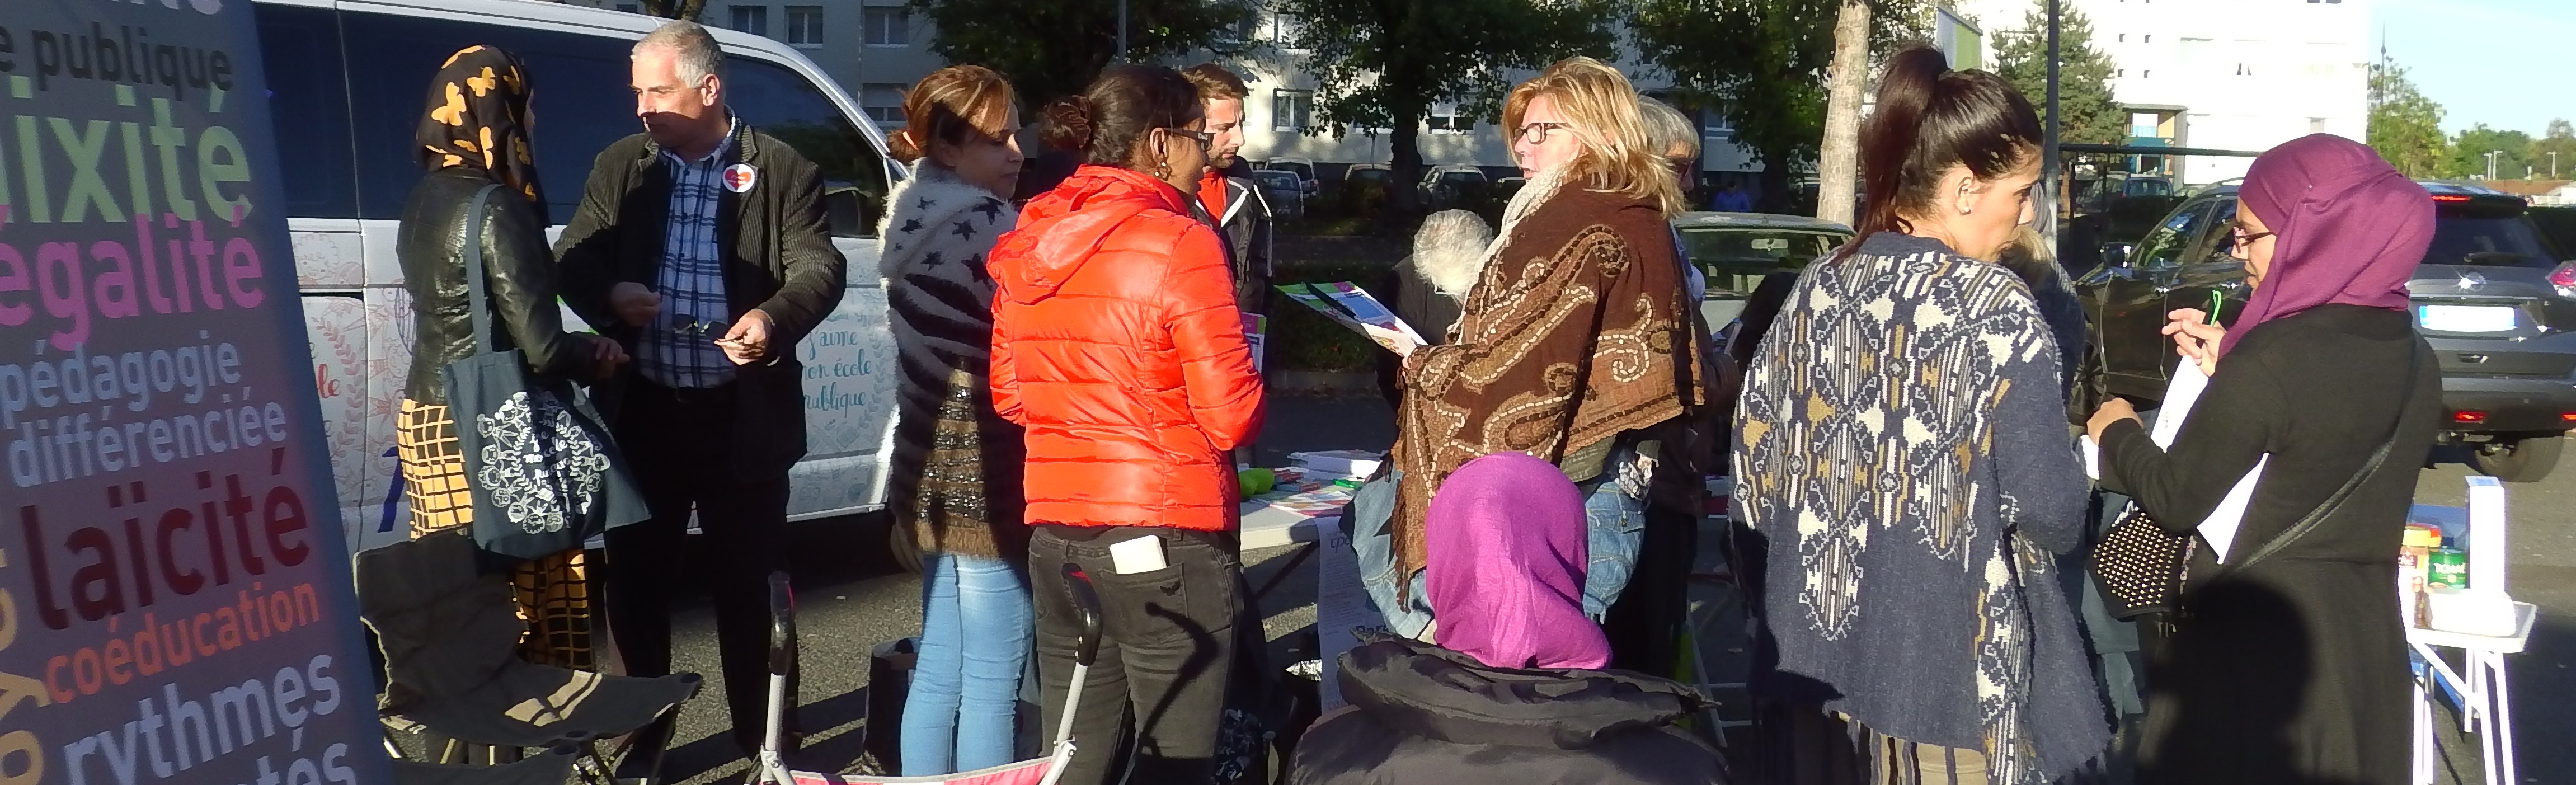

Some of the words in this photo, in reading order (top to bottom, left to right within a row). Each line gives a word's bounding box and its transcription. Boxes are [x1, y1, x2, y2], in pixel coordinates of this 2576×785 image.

[31, 21, 233, 101] publique
[0, 75, 254, 223] ixité
[0, 330, 242, 430] pédagogie
[834, 348, 872, 378] école
[8, 386, 287, 488] différenciée
[21, 447, 310, 631] laïcité
[45, 581, 322, 705] coéducation
[64, 654, 341, 785] rythmes
